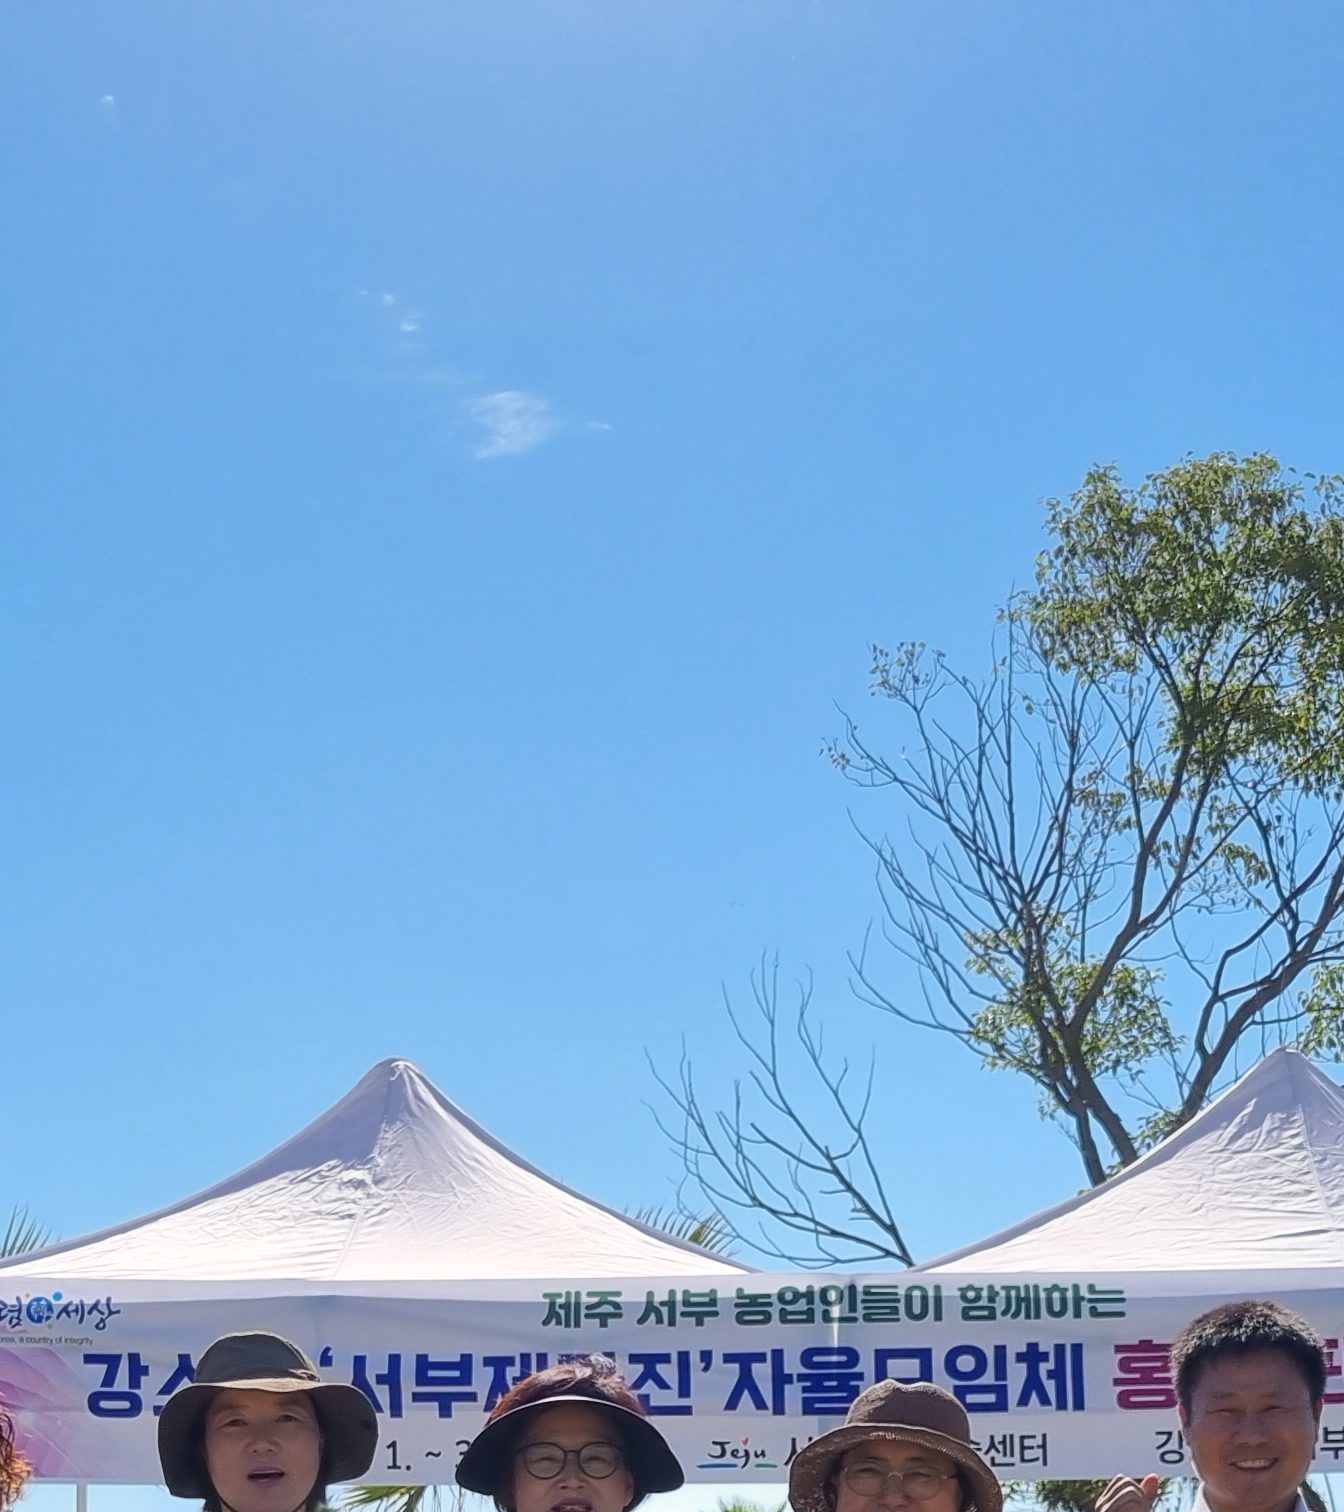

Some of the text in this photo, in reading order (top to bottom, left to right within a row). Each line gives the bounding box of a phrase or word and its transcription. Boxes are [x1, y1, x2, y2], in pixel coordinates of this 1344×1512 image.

[541, 1283, 1127, 1329] 제주 서부 농업인들이 함께하는
[1112, 1339, 1178, 1411] 홍
[707, 1438, 766, 1468] Jeju
